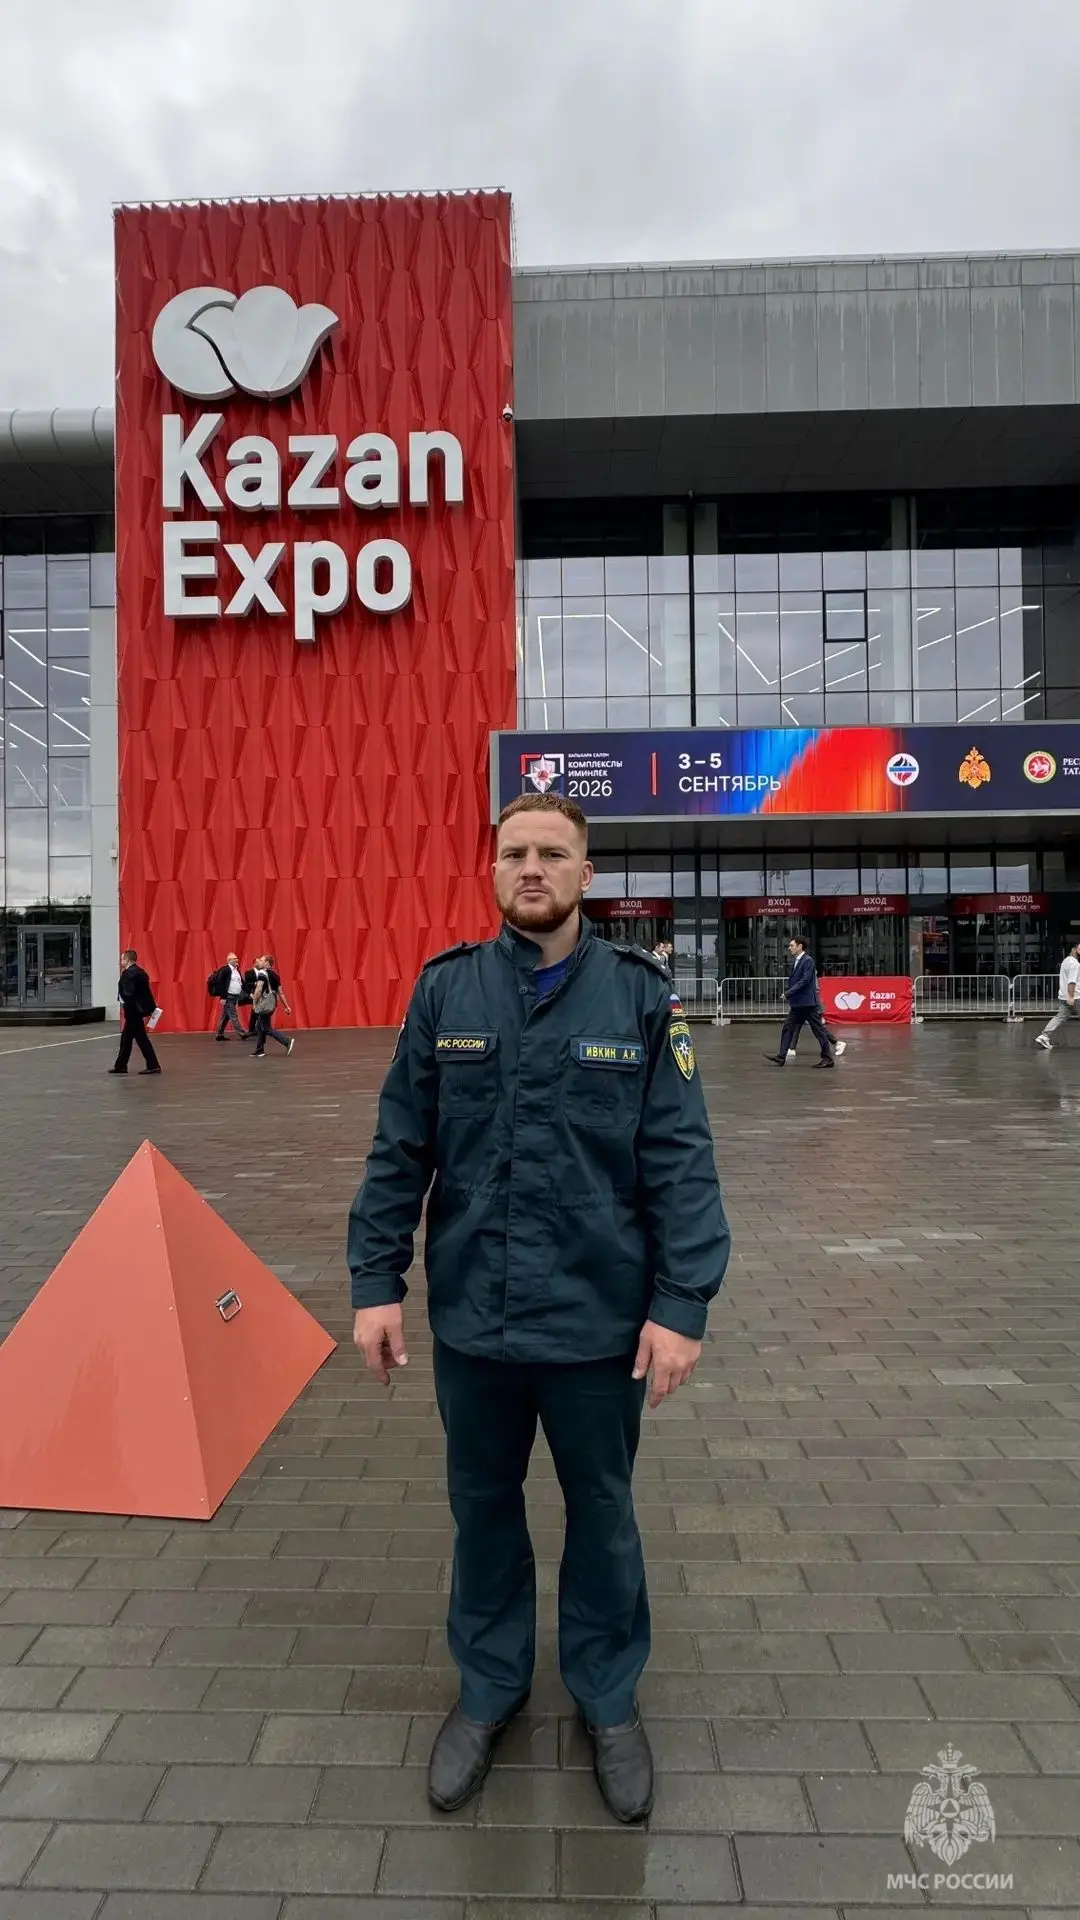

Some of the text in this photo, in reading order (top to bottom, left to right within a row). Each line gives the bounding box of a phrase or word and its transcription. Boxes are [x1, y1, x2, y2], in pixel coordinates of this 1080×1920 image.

[162, 413, 464, 512] Kazan
[162, 520, 412, 643] Expo
[568, 760, 623, 768] КОМПЛЕКСЛЫ
[568, 769, 608, 777] ИМИНЛЕК
[1063, 767, 1080, 775] ТАТ
[678, 775, 782, 792] СЕНТЯБРЬ
[568, 780, 612, 797] 2026
[768, 898, 792, 906] ВХОД
[863, 897, 887, 905] ВХОД
[1009, 895, 1034, 903] ВХОД
[620, 900, 642, 908] ВХОД
[870, 991, 896, 999] Kazan
[870, 1001, 891, 1011] Expo
[452, 1039, 485, 1048] РОССИИ
[586, 1046, 616, 1058] ИВКИН
